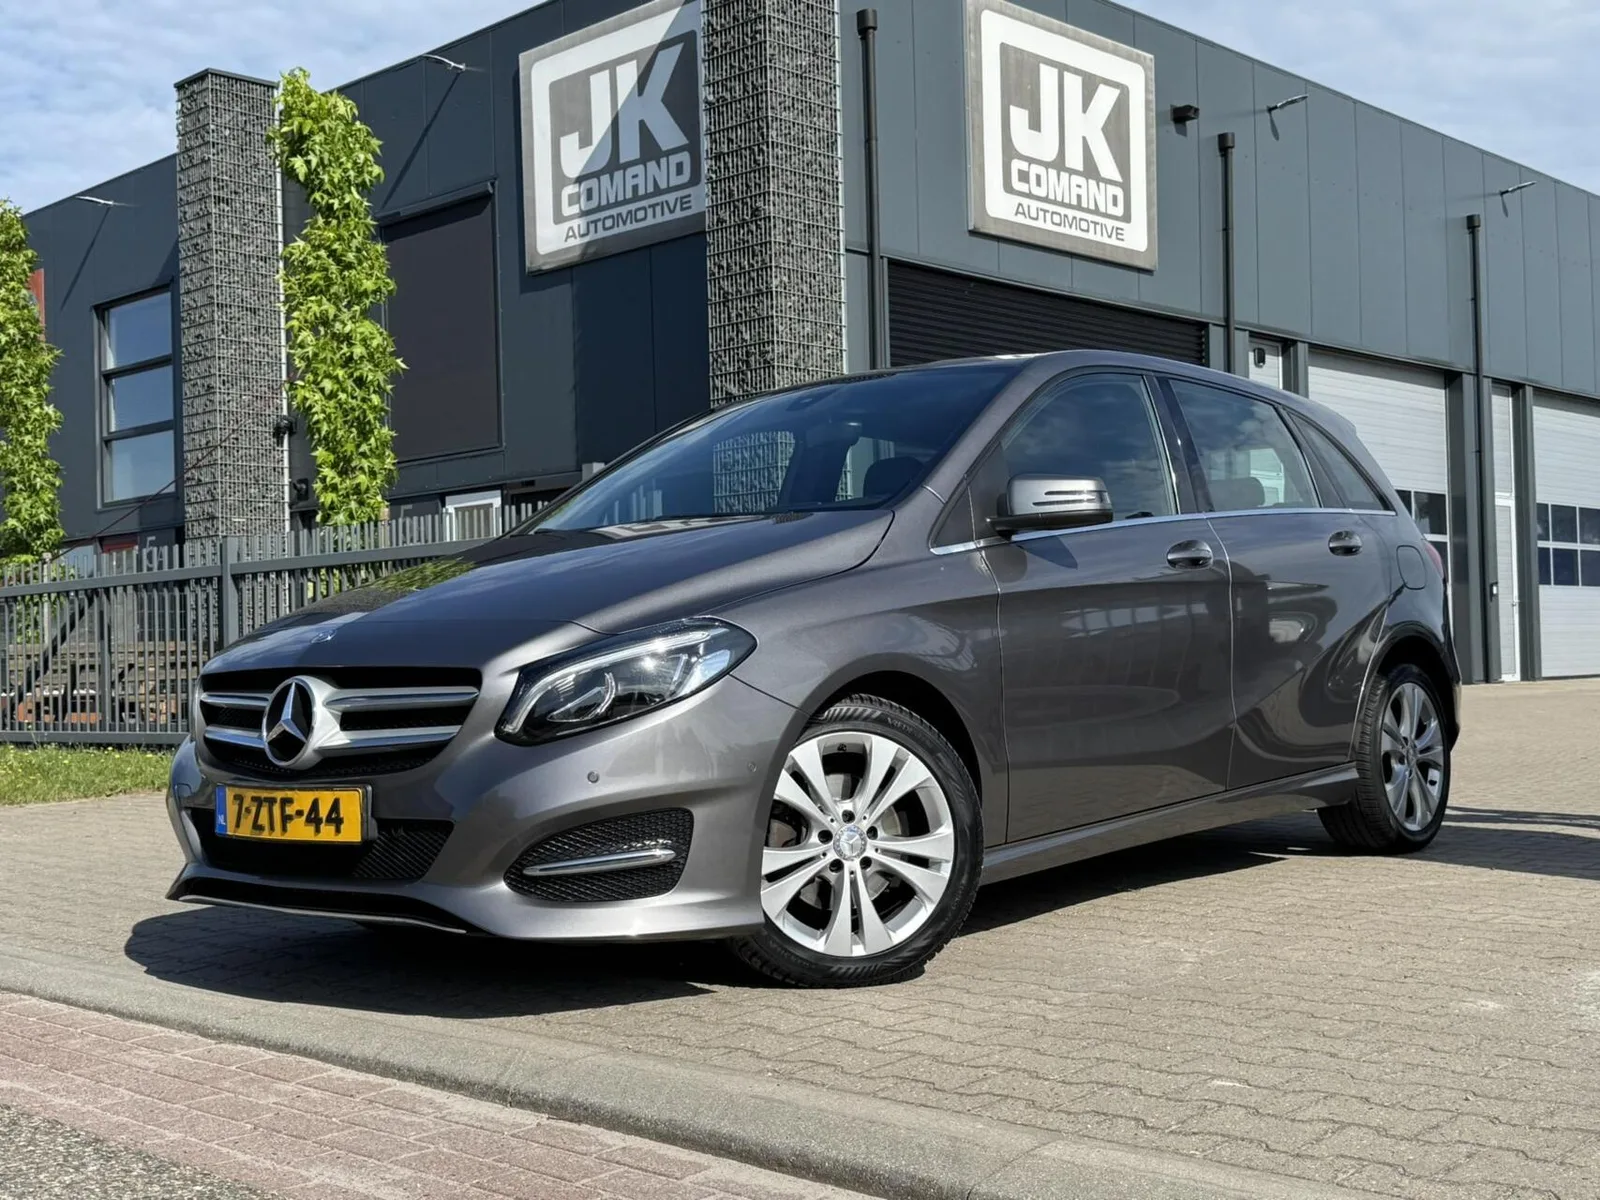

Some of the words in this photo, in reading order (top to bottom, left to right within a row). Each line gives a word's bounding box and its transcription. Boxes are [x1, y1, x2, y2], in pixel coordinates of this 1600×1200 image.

[560, 42, 689, 178] JK
[1009, 62, 1123, 183] JK
[561, 151, 691, 217] COMAND
[1011, 158, 1125, 218] COMAND
[564, 193, 692, 242] AUTOMOTIVE
[1014, 202, 1125, 241] AUTOMOTIVE
[218, 814, 226, 825] NL
[233, 794, 344, 834] 7-ZTF-44
